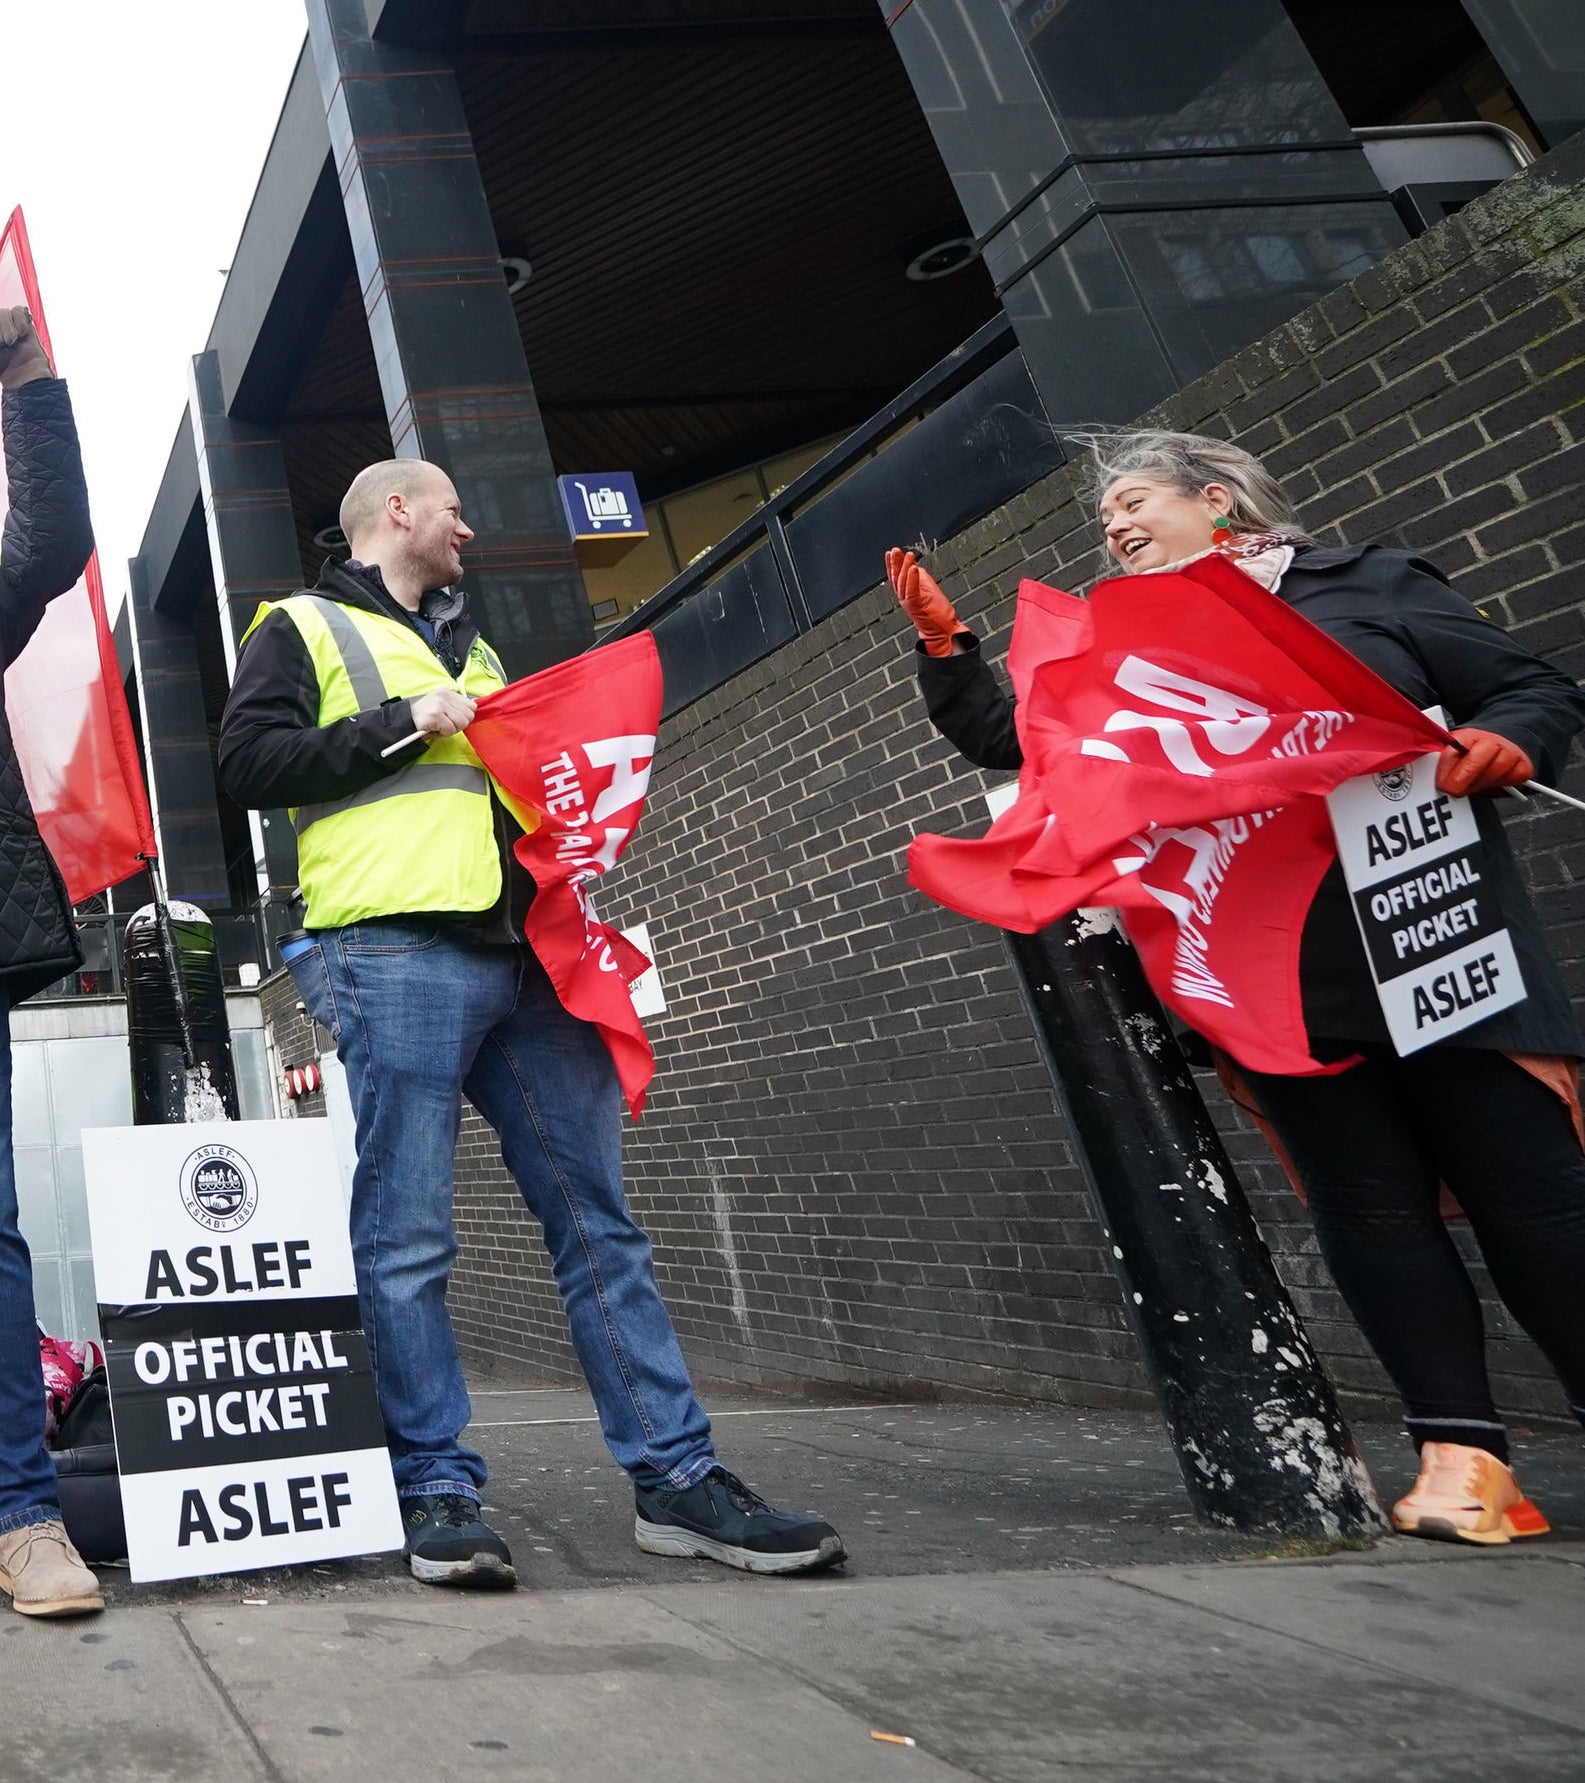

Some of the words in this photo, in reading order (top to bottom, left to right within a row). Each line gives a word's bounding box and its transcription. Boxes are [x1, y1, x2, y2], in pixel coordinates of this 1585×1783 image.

[540, 750, 585, 816] THE
[1365, 796, 1454, 867] ASLEF
[1370, 857, 1482, 922] OFFICIAL
[1391, 898, 1481, 960] PICKET
[1413, 952, 1501, 1030] ASLEF
[196, 1147, 234, 1160] ASLEF
[234, 1201, 253, 1225] 1880
[145, 1240, 312, 1299] ASLEF
[134, 1329, 348, 1384] OFFICIAL
[167, 1383, 330, 1442] PICKET
[178, 1472, 352, 1547] ASLEF
